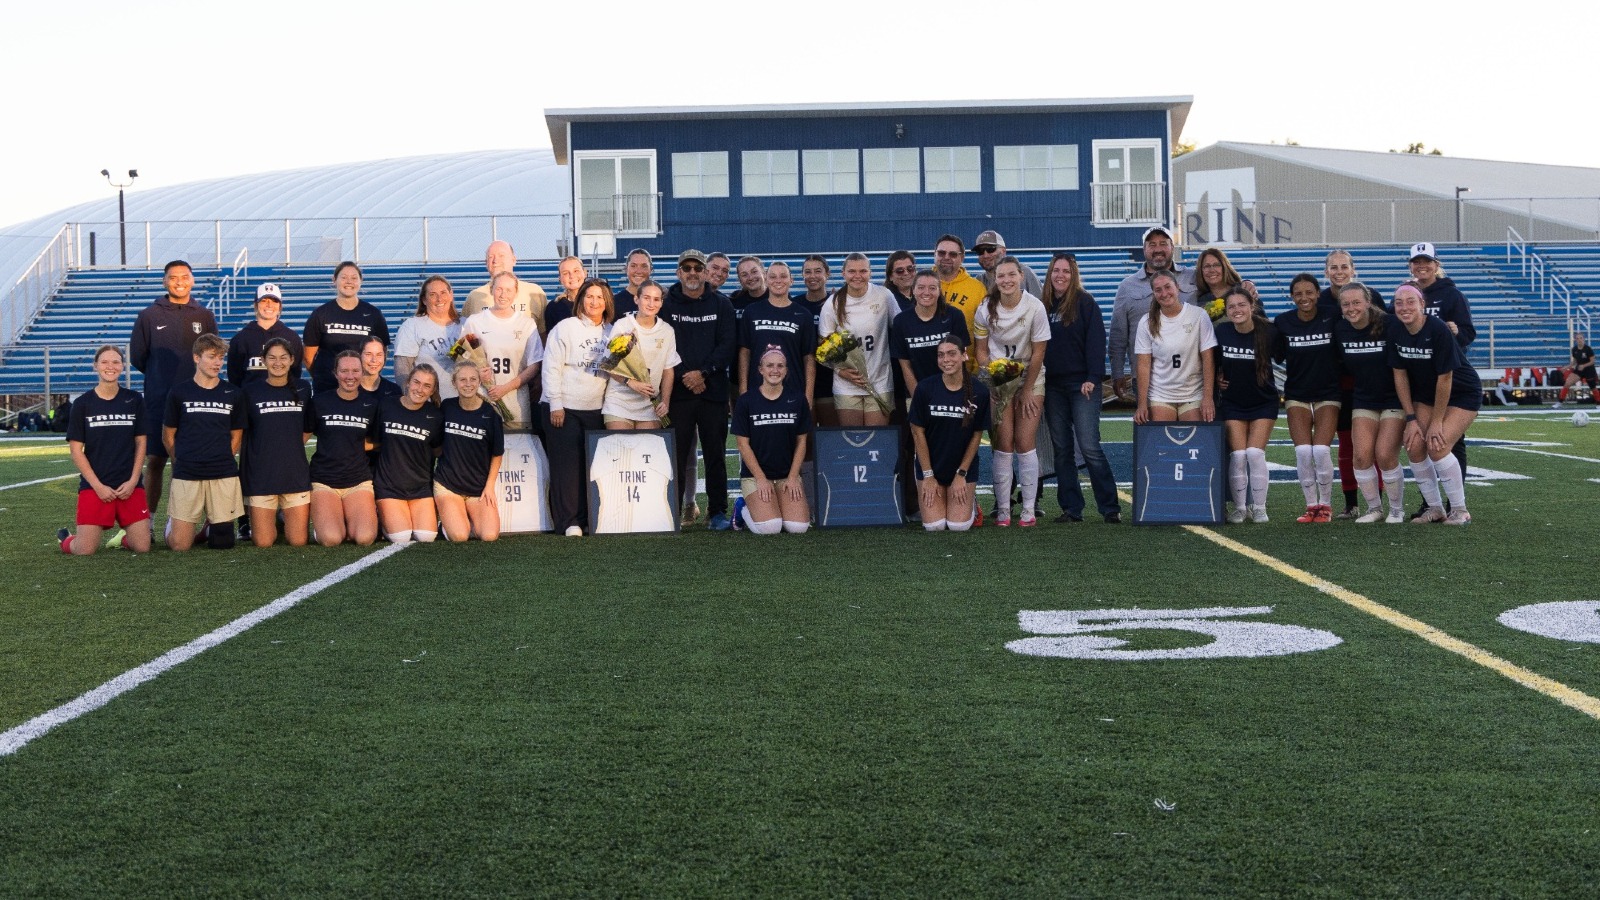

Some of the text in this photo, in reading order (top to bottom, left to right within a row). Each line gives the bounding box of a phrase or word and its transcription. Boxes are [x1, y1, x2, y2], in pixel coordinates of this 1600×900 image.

[1186, 207, 1293, 245] RINE
[325, 323, 372, 332] TRINE
[752, 319, 800, 331] TRINE
[1286, 332, 1333, 342] TRINE
[579, 337, 607, 350] TRIN
[1342, 340, 1387, 348] TRINE
[1395, 342, 1434, 355] TRINE
[1222, 345, 1255, 355] TRIN
[492, 358, 511, 374] 39
[1171, 354, 1182, 369] 6
[183, 401, 234, 411] TRINE
[256, 400, 304, 408] TRINE
[86, 413, 137, 422] TRINE
[322, 414, 370, 425] TRINE
[749, 412, 798, 421] TRINE
[384, 421, 431, 437] TRINE
[445, 421, 487, 436] TRINE
[521, 454, 530, 464] T
[642, 454, 651, 464] T
[868, 450, 879, 462] T
[1188, 448, 1199, 459] T
[498, 469, 526, 483] TRINE
[619, 470, 647, 483] TRINE
[854, 465, 868, 483] 12
[1174, 463, 1183, 480] 6
[505, 484, 522, 502] 39
[627, 485, 640, 503] 14
